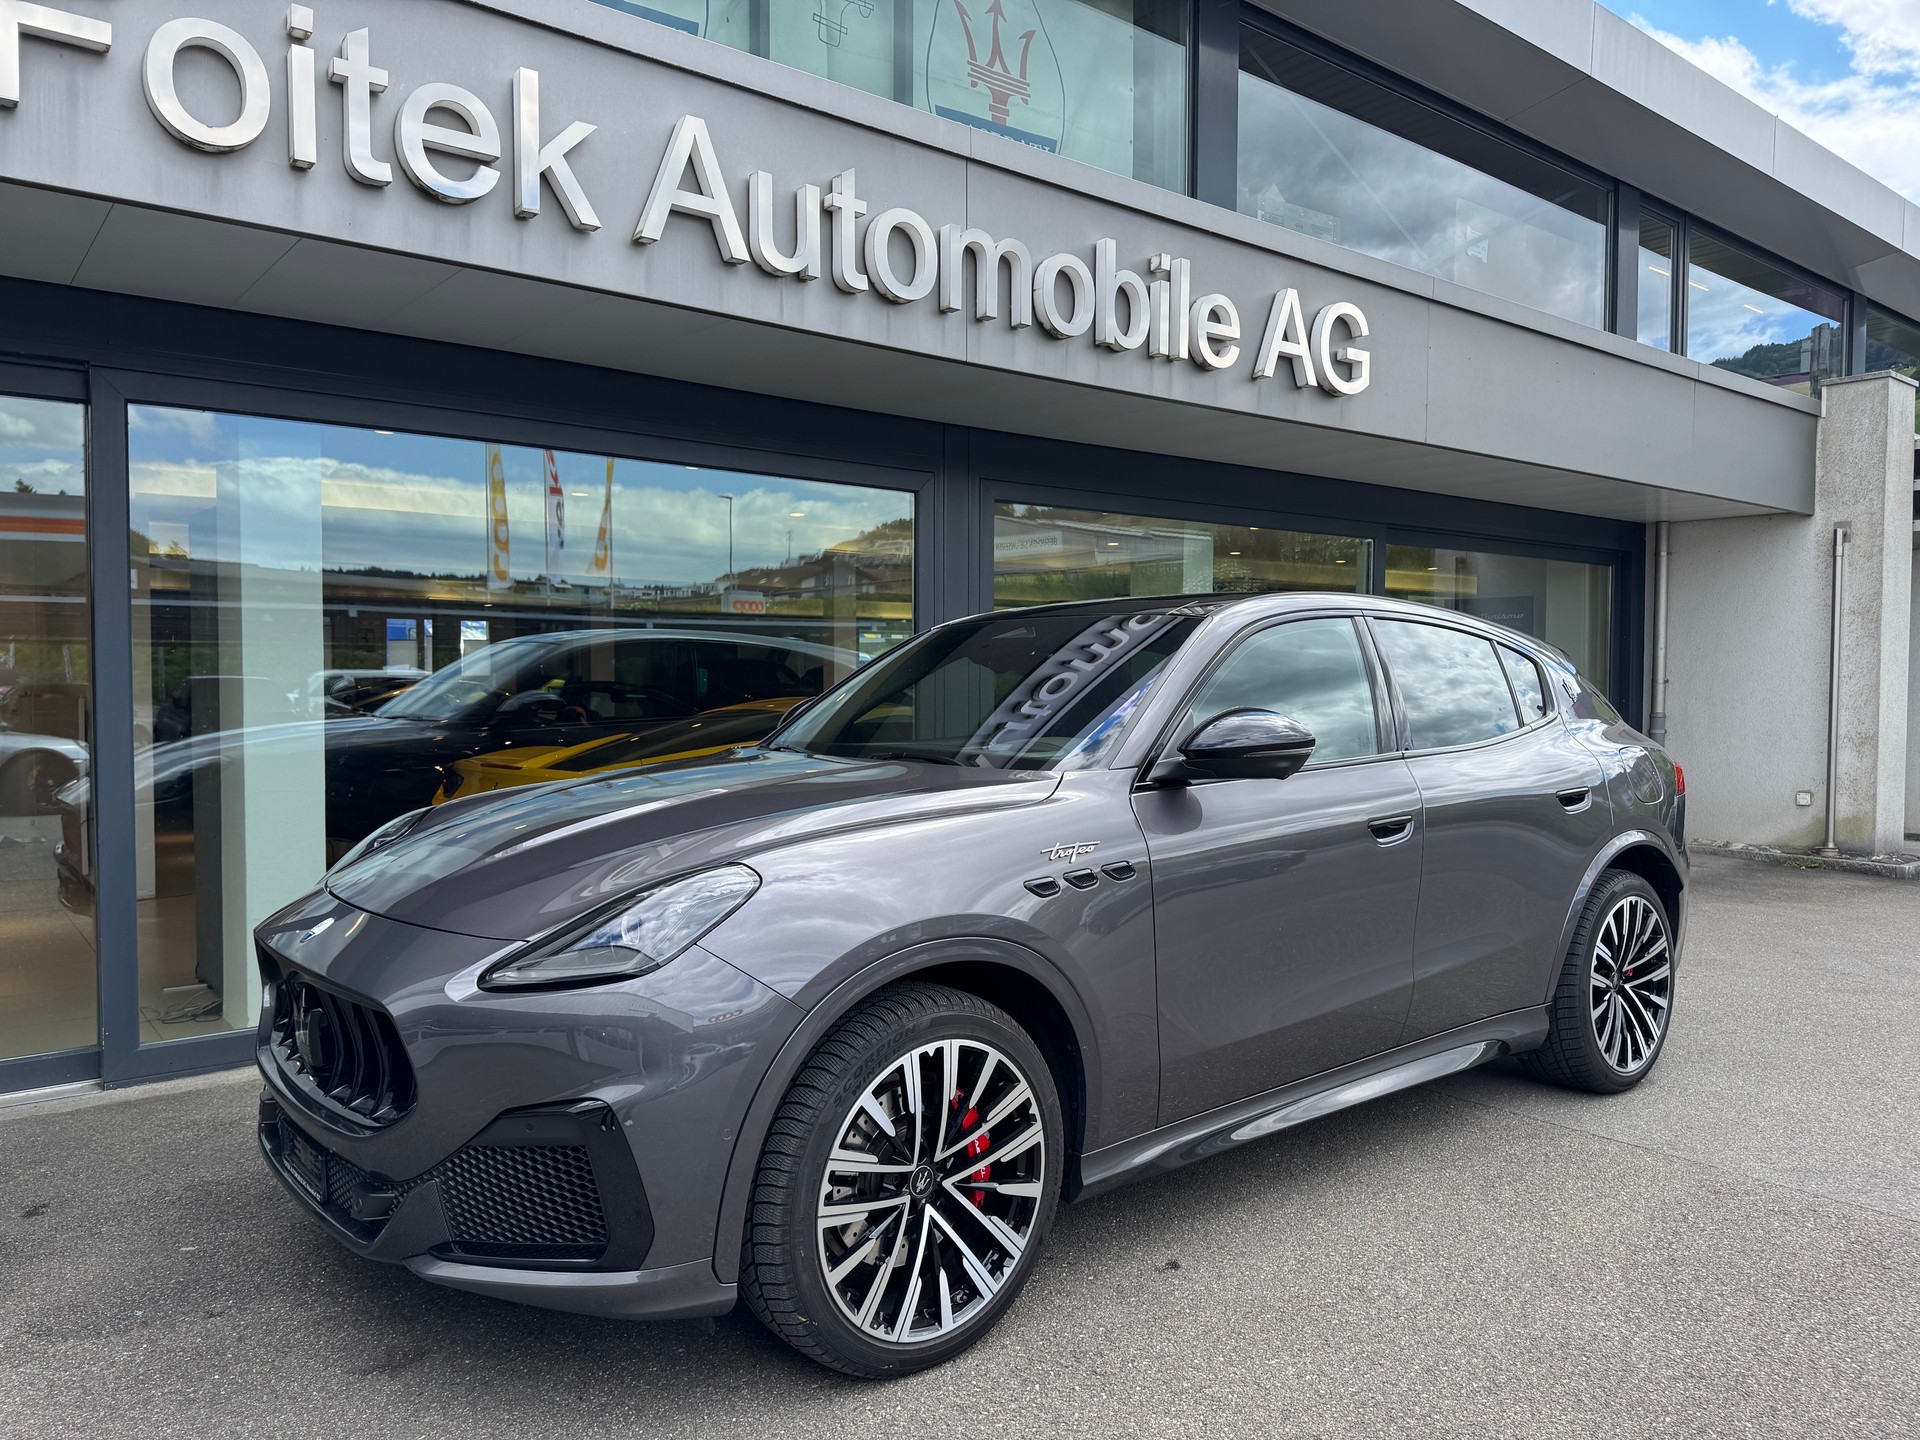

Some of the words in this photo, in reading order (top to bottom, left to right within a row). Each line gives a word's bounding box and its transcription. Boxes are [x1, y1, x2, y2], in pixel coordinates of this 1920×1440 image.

[632, 114, 1242, 371] Automobile
[1252, 287, 1371, 398] AG
[1040, 841, 1101, 863] trofeo
[833, 1024, 918, 1108] SCORPION
